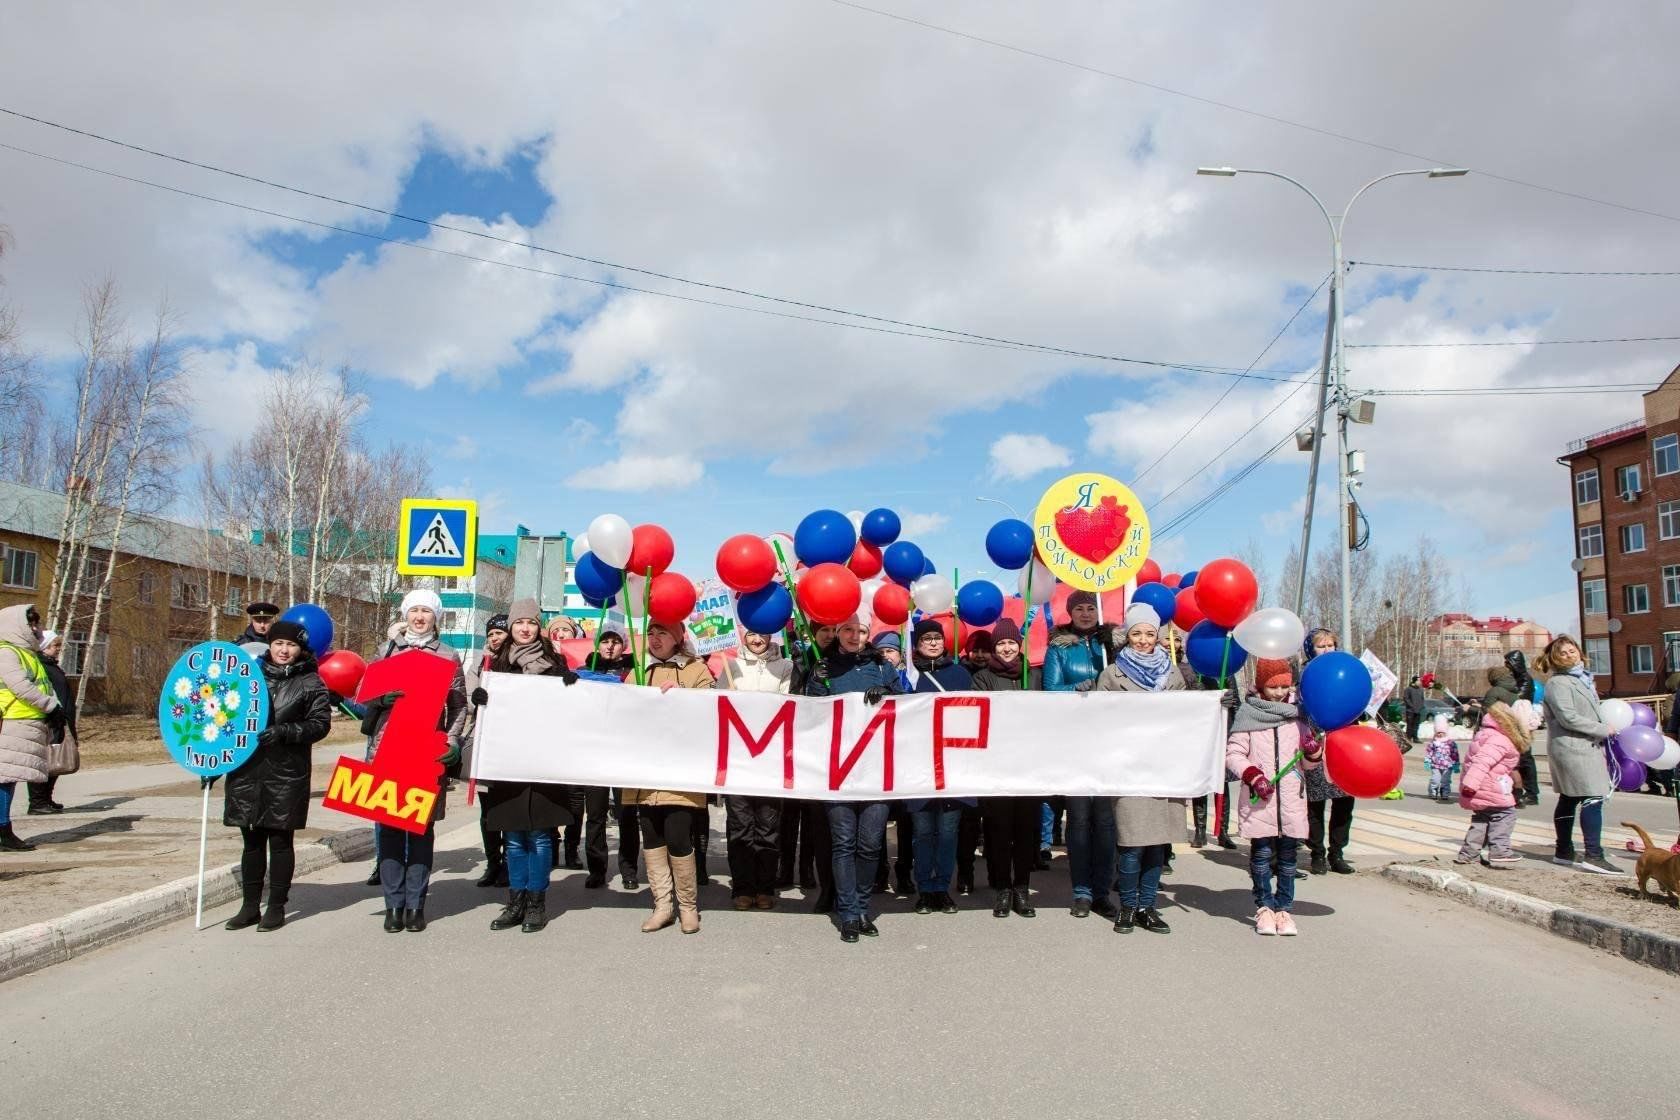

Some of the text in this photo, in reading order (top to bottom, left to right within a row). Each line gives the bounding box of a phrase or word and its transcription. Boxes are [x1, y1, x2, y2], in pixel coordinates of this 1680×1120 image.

[1063, 482, 1100, 513] Я
[1039, 523, 1144, 587] ПОЙКОВСКИЙ
[695, 594, 730, 613] МАЯ
[188, 652, 203, 671] С
[355, 647, 459, 790] 1
[715, 695, 991, 792] МИР
[327, 765, 437, 825] МАЯ
